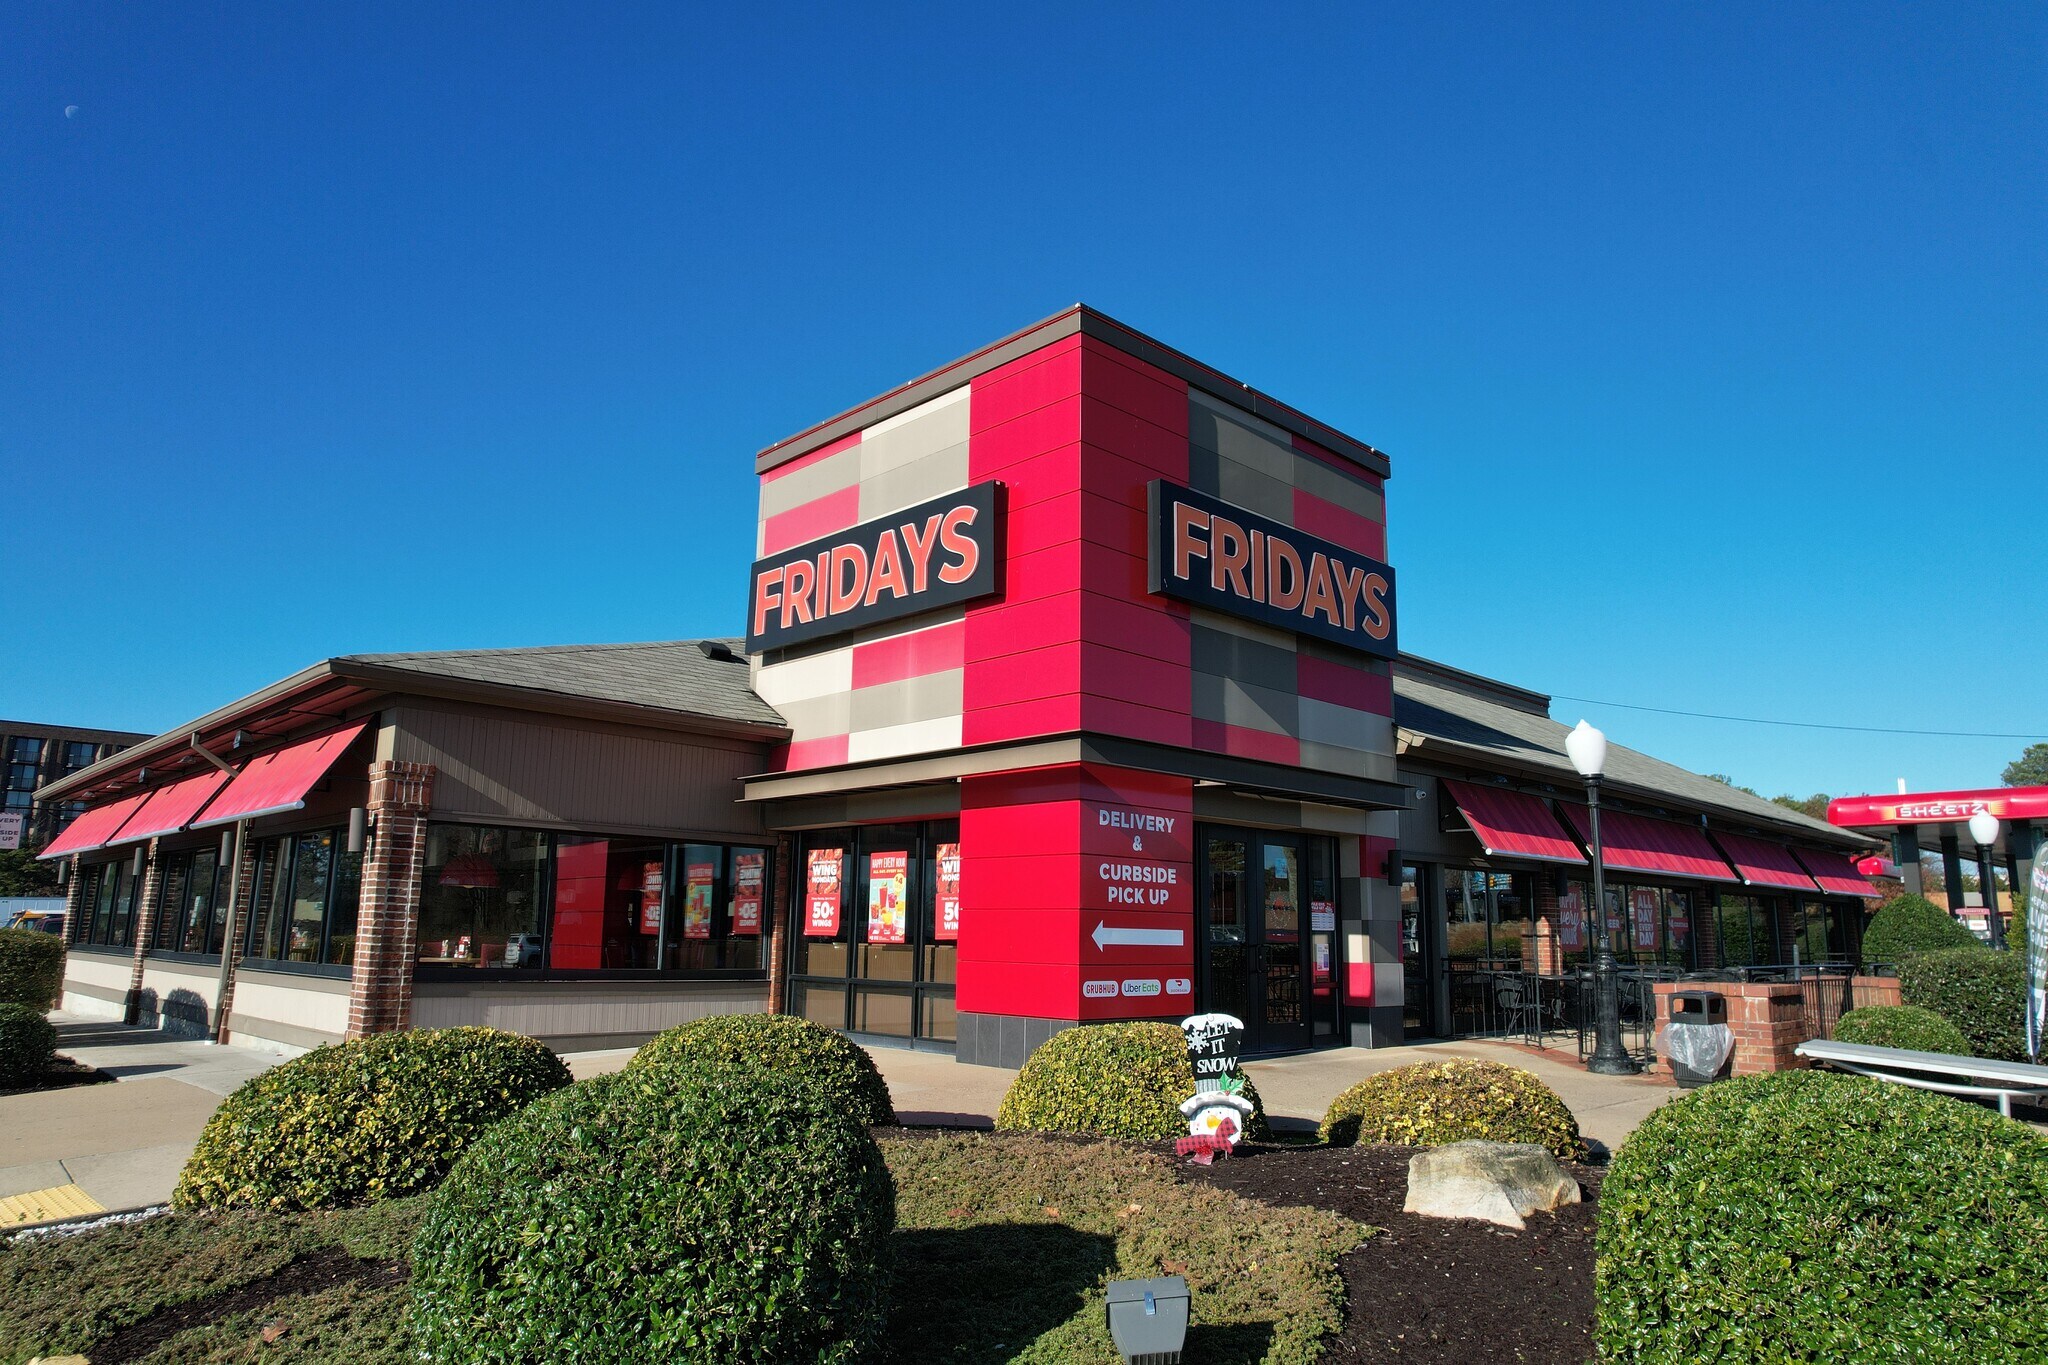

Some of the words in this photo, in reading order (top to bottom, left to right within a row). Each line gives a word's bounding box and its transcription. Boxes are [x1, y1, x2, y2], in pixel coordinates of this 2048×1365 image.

[753, 505, 980, 637] FRIDAYS
[1173, 501, 1391, 640] FRIDAYS
[1900, 803, 1984, 817] SHEETZ
[1099, 809, 1175, 833] DELIVERY
[1132, 835, 1143, 852] &
[812, 864, 837, 876] WING
[1099, 863, 1177, 884] CURBSIDE
[1108, 886, 1145, 904] PICK
[1149, 888, 1169, 905] UP
[1637, 894, 1652, 909] ALL
[812, 901, 835, 919] 50¢
[1637, 909, 1653, 922] DAY
[812, 919, 832, 928] WINGS
[1638, 923, 1654, 931] EVERY
[1639, 931, 1655, 945] DAY
[1086, 984, 1116, 994] GRUBHUB
[1124, 983, 1141, 993] Uber
[1142, 983, 1159, 992] Eats
[1205, 1021, 1232, 1038] LET
[1210, 1038, 1226, 1054] IT
[1197, 1056, 1238, 1073] SNOW
